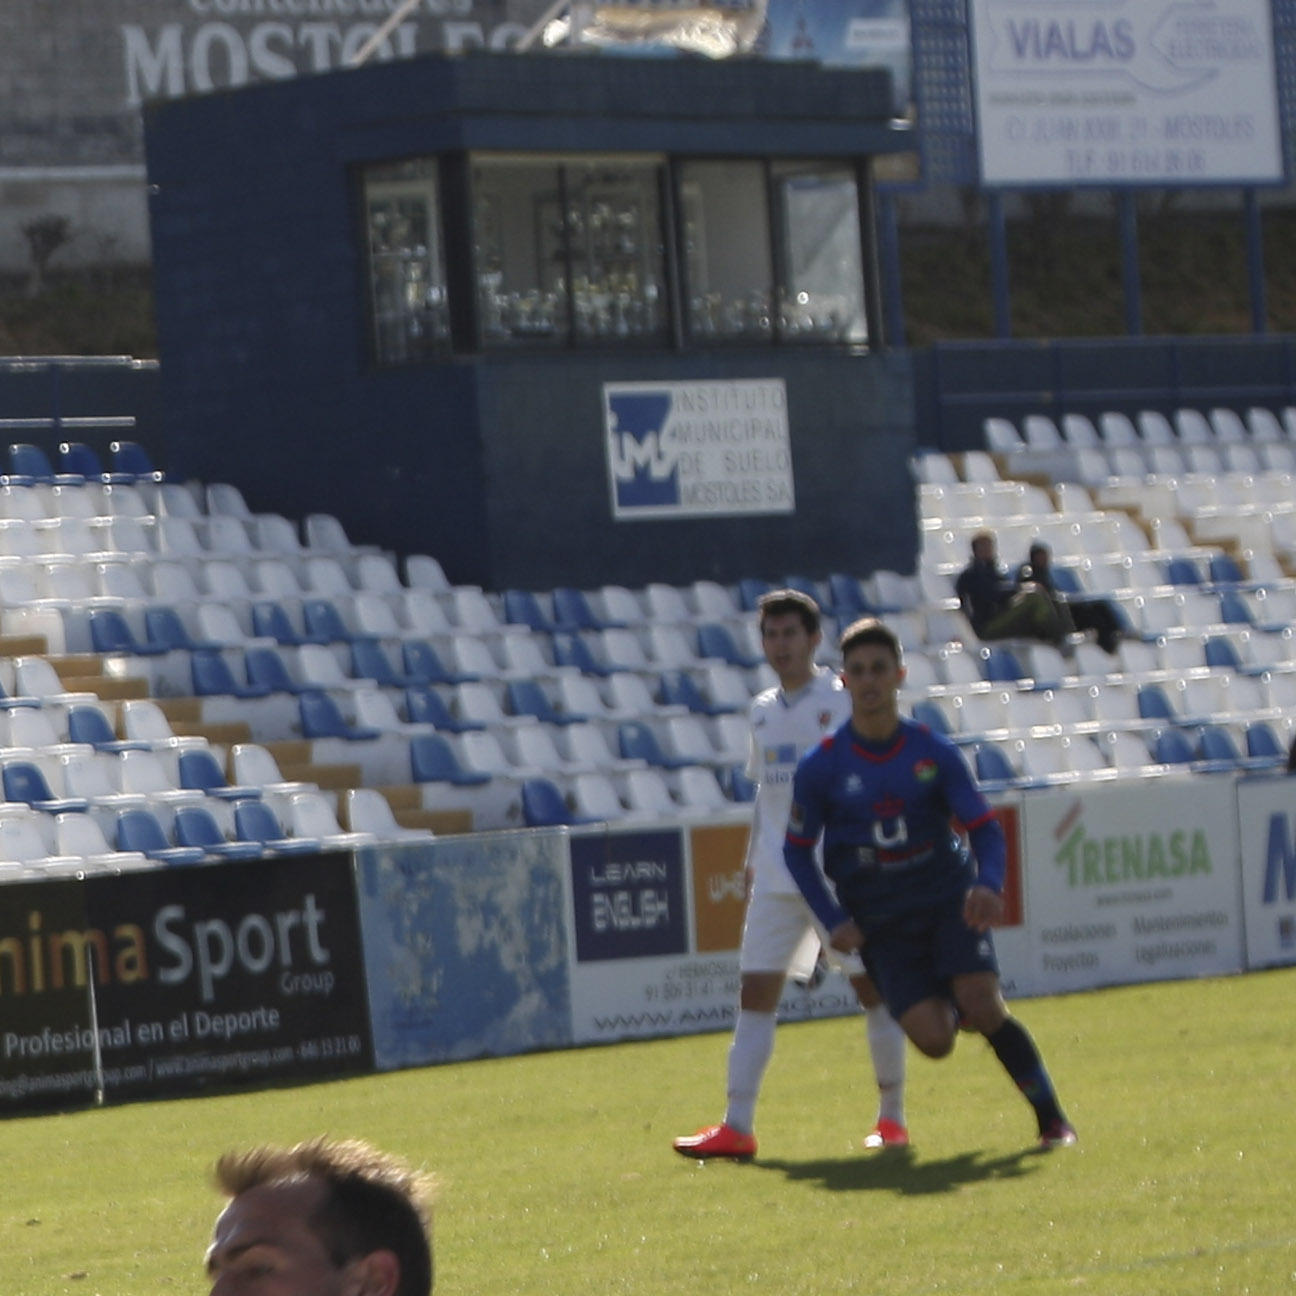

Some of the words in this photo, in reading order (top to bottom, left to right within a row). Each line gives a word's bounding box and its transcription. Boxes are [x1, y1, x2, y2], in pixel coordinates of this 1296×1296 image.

[1009, 18, 1136, 61] VIALAS
[1054, 803, 1214, 888] TRENASA
[590, 861, 667, 883] LEARN
[592, 888, 670, 932] ENGLISH
[280, 969, 335, 996] Group
[6, 1018, 132, 1058] Profesional
[136, 1021, 164, 1044] en
[170, 1012, 189, 1040] el
[194, 1006, 281, 1040] Deporte
